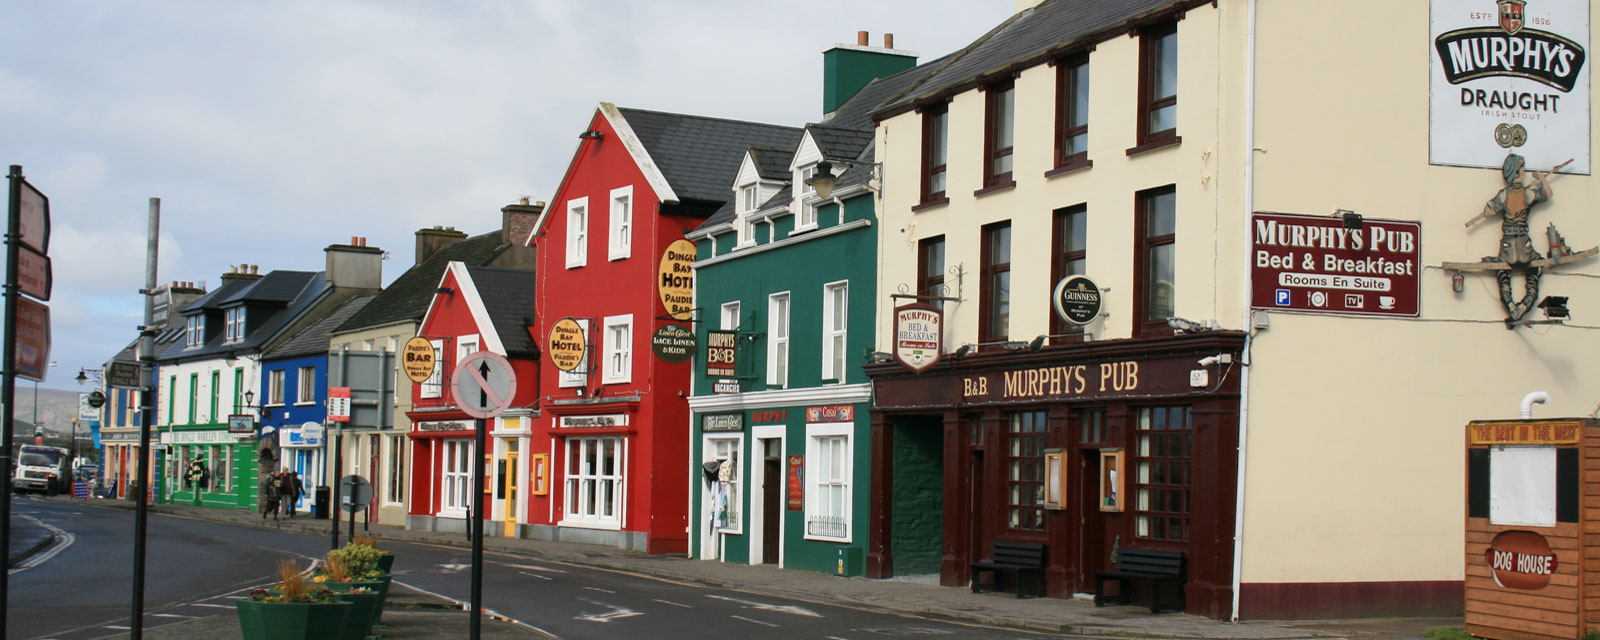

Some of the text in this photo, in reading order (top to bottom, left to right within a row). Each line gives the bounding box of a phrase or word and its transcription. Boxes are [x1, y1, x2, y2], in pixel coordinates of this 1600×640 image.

[1531, 17, 1551, 26] 1856
[1447, 36, 1576, 78] MURPHY'S
[1461, 87, 1560, 113] DRAUGHT
[1481, 110, 1541, 120] IRISH STOUT
[1255, 219, 1414, 252] MURPHY'S PUB
[673, 262, 692, 273] BAY
[1256, 250, 1413, 275] Bed & Breakfast
[662, 273, 693, 288] HOT
[1284, 274, 1385, 289] Rooms En Suite
[665, 294, 693, 304] PAUDIE
[1064, 290, 1098, 301] GUINNESS
[1278, 292, 1288, 303] P
[1347, 297, 1357, 305] TV
[672, 304, 690, 314] BAR
[900, 311, 939, 324] MURPHY'S
[556, 326, 578, 334] DINGLE
[908, 322, 928, 332] BED &
[653, 337, 695, 346] LACE LINEN
[899, 331, 937, 341] BREAKFAST
[552, 340, 582, 351] HOTEL
[406, 352, 431, 362] BAR
[708, 348, 735, 363] B&B
[1003, 365, 1086, 398] MURPHY'S
[1099, 361, 1139, 391] PUB
[752, 409, 787, 423] MURPHY
[1495, 425, 1516, 441] BEST
[1519, 425, 1528, 441] IN
[1533, 424, 1550, 441] THE
[1493, 550, 1552, 575] DOG HOUSE
